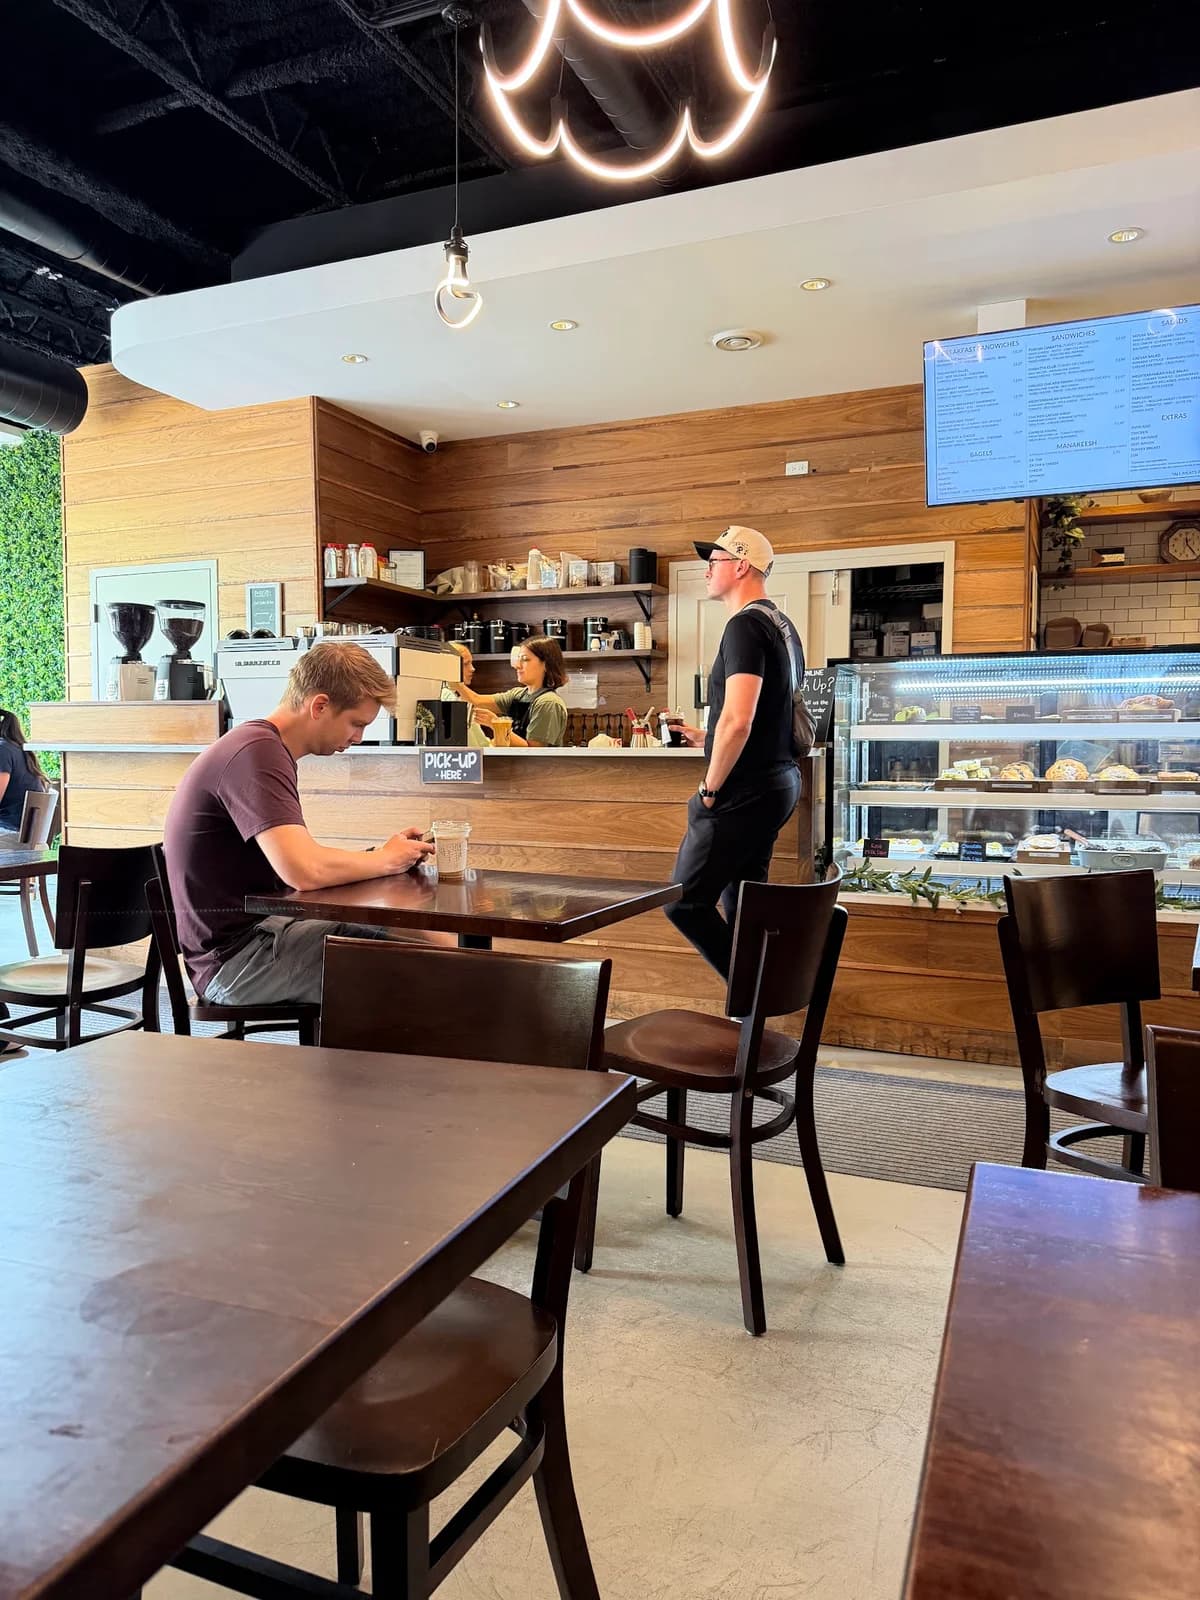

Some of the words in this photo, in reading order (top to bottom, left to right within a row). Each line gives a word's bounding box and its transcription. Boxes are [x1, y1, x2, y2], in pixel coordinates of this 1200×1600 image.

[1161, 318, 1188, 326] SALDS
[1051, 330, 1096, 342] SANDWICHES
[424, 752, 477, 768] PICK-UP
[440, 770, 462, 780] HERE
